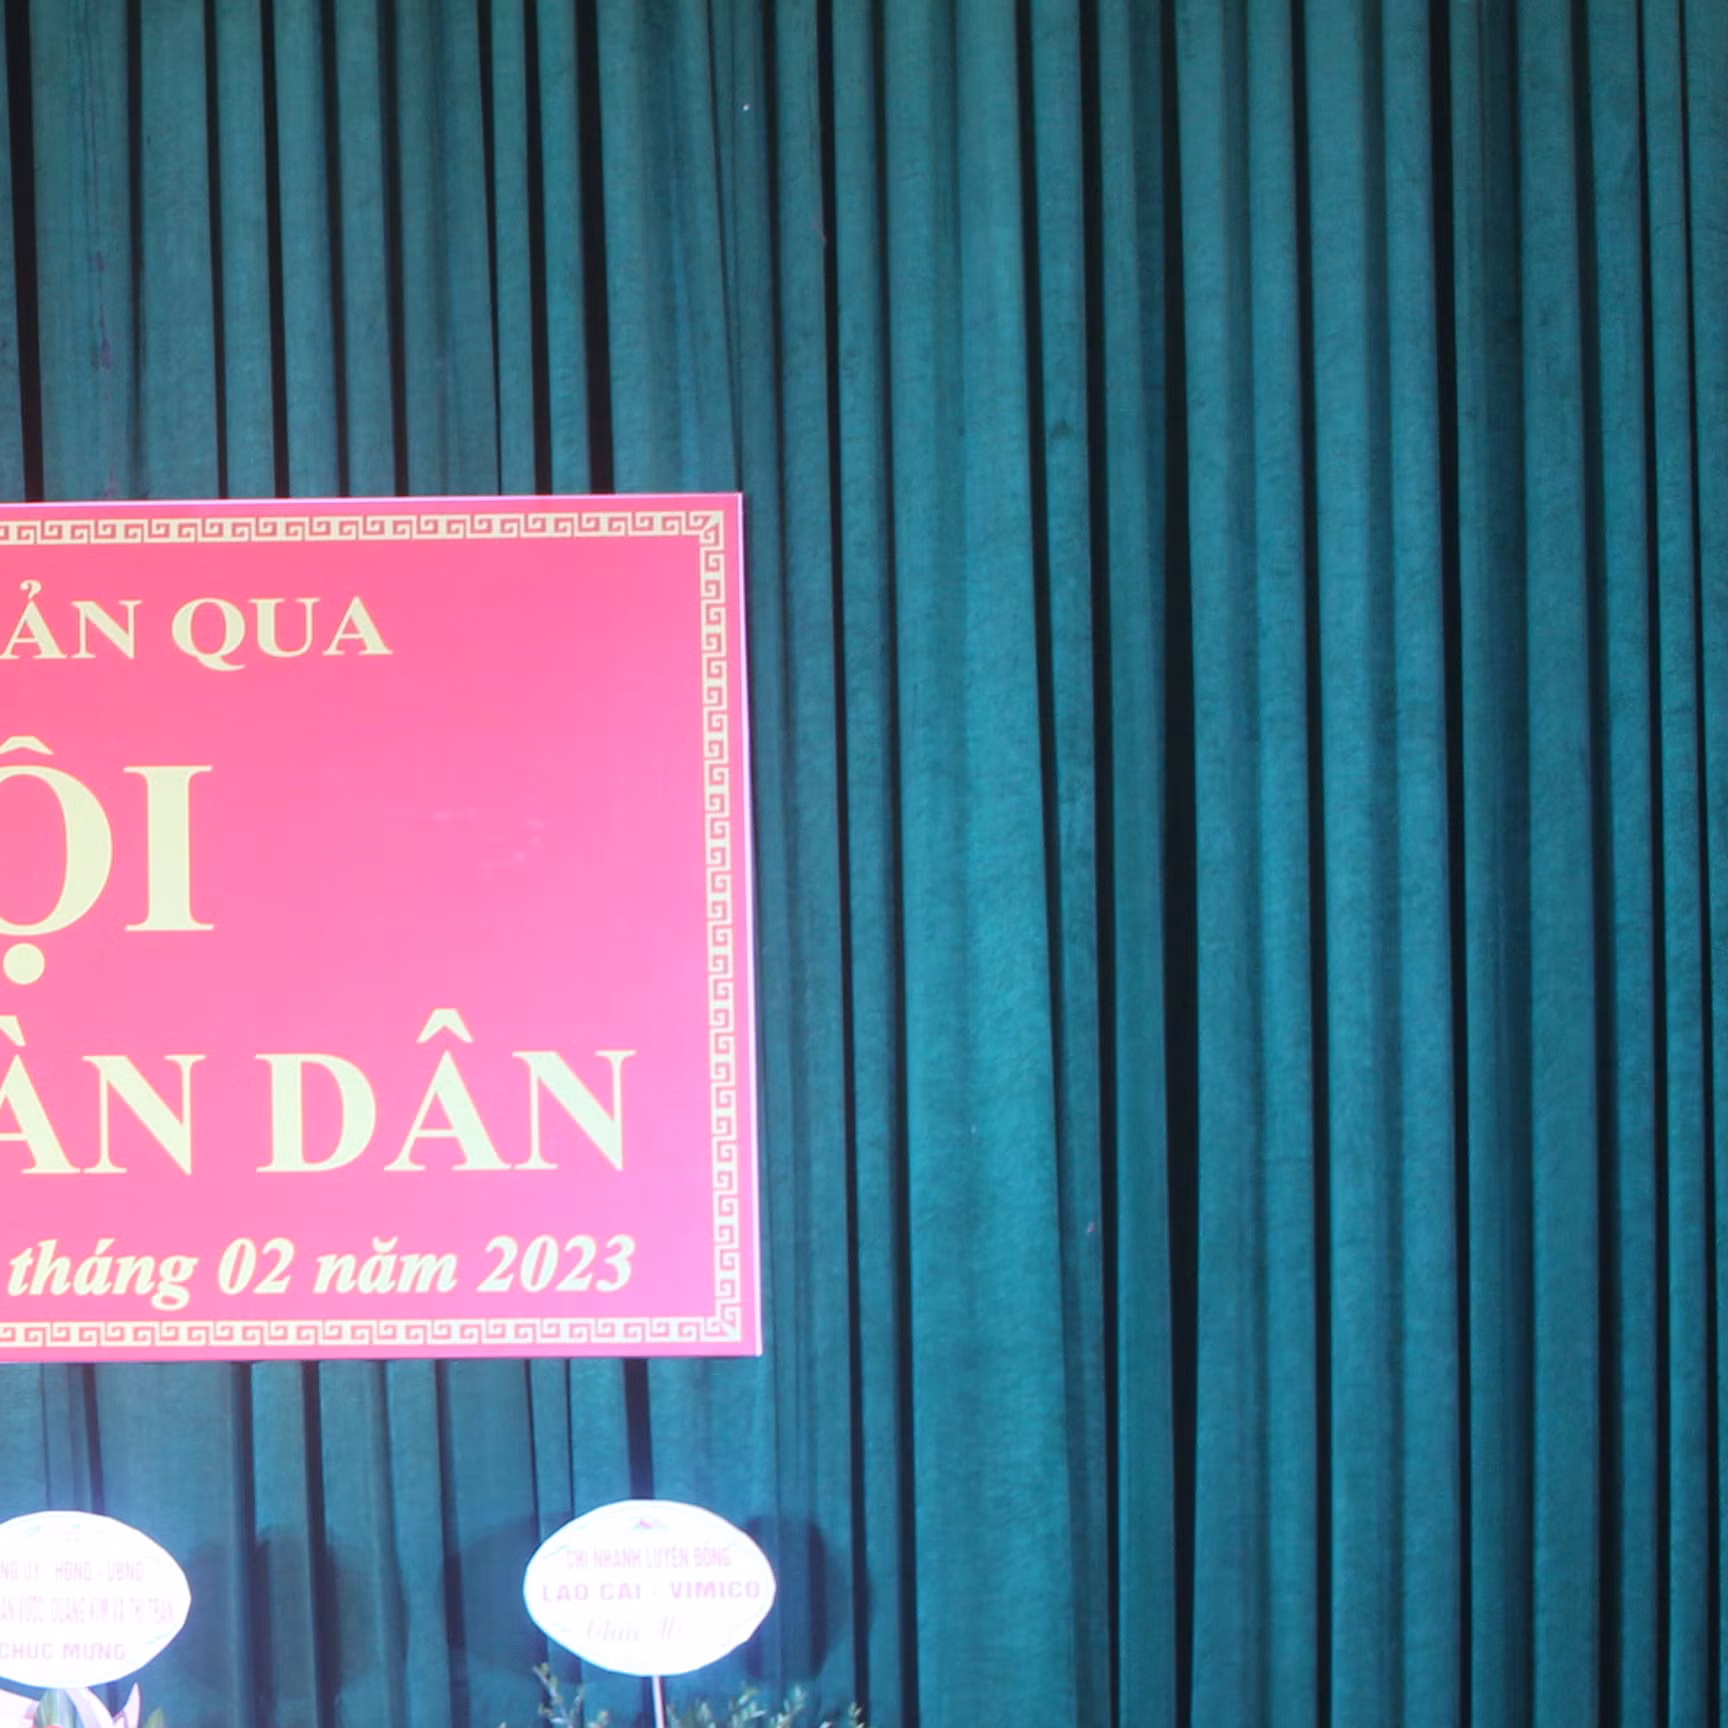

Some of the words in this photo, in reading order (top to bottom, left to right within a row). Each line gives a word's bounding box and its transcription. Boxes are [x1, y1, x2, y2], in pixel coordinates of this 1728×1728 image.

[171, 596, 394, 672] QUA
[255, 1007, 634, 1172] DÂN
[7, 1238, 198, 1311] tháng
[218, 1238, 295, 1294] 02
[313, 1236, 457, 1293] năm
[477, 1235, 636, 1293] 2023
[669, 1579, 762, 1601] VIMICO
